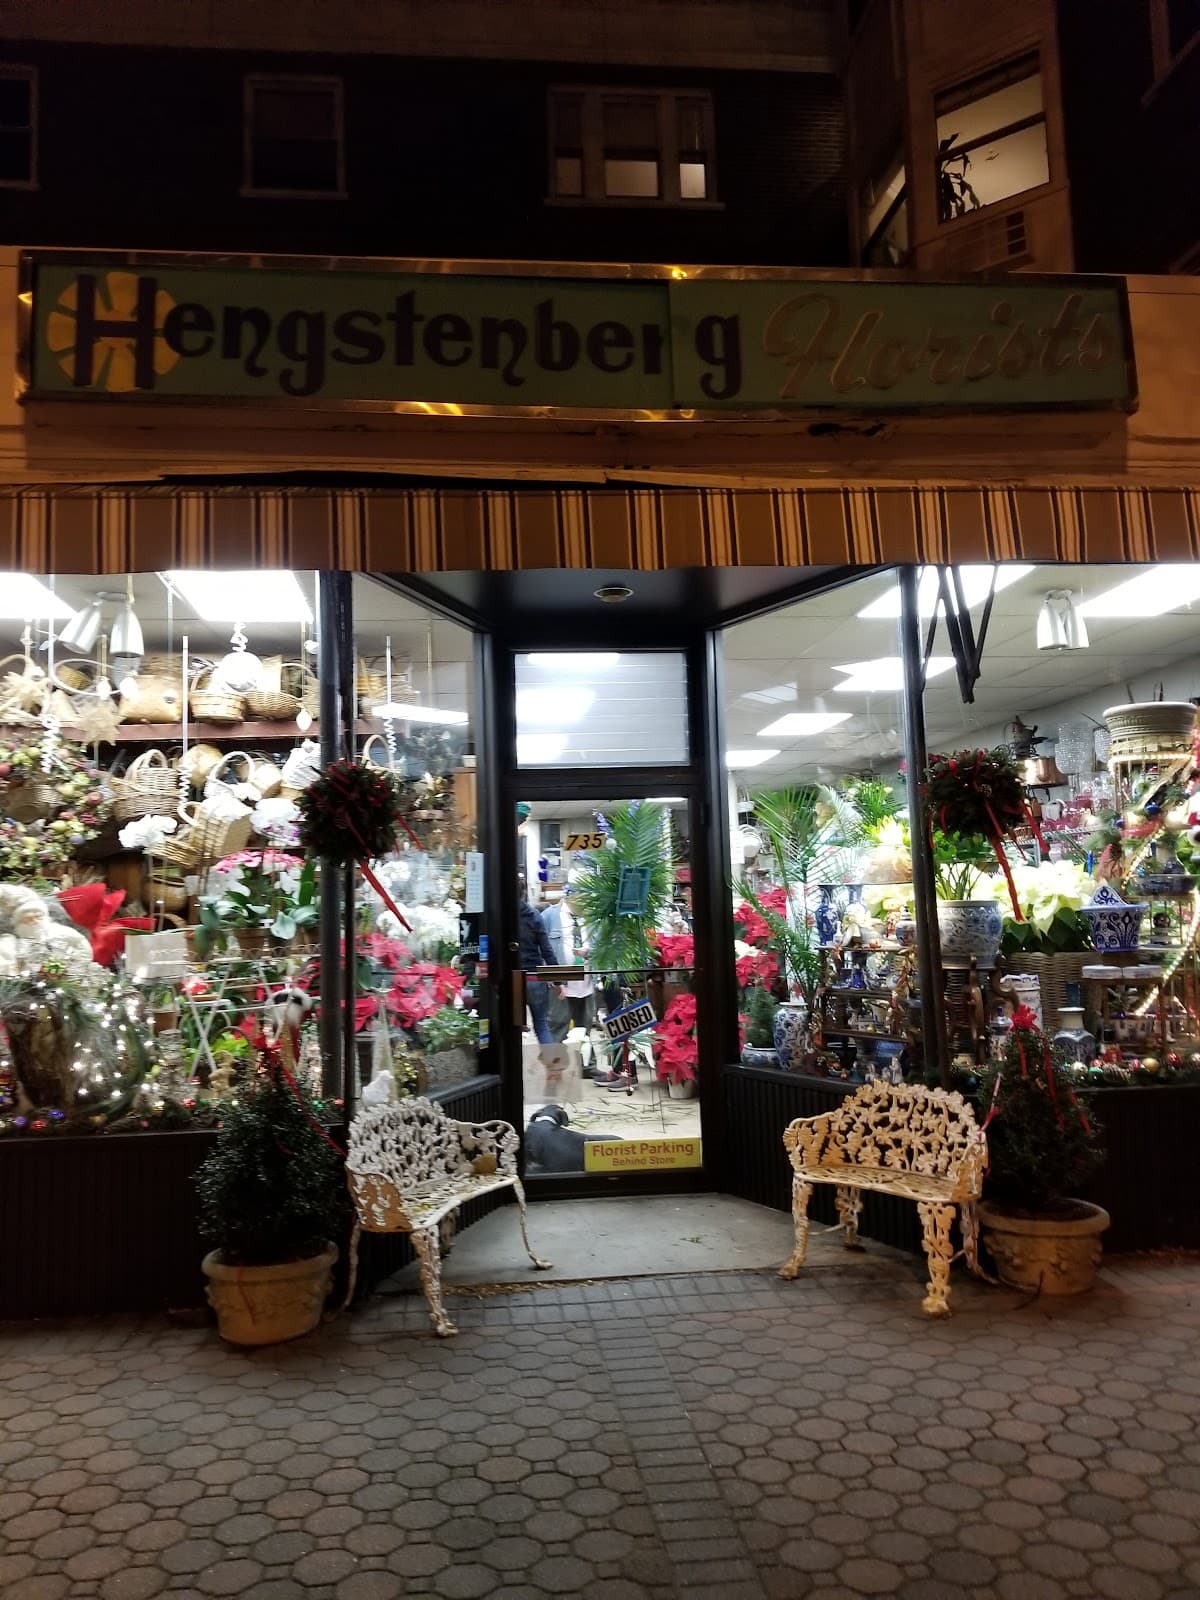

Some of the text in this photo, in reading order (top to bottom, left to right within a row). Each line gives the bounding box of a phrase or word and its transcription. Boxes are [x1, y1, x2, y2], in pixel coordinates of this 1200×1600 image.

[74, 273, 1115, 399] Hengstenberg Florists
[567, 833, 606, 850] 735
[606, 1005, 653, 1038] CLOSED
[592, 1141, 694, 1157] Florist Parking
[612, 1155, 676, 1167] Behind Store
